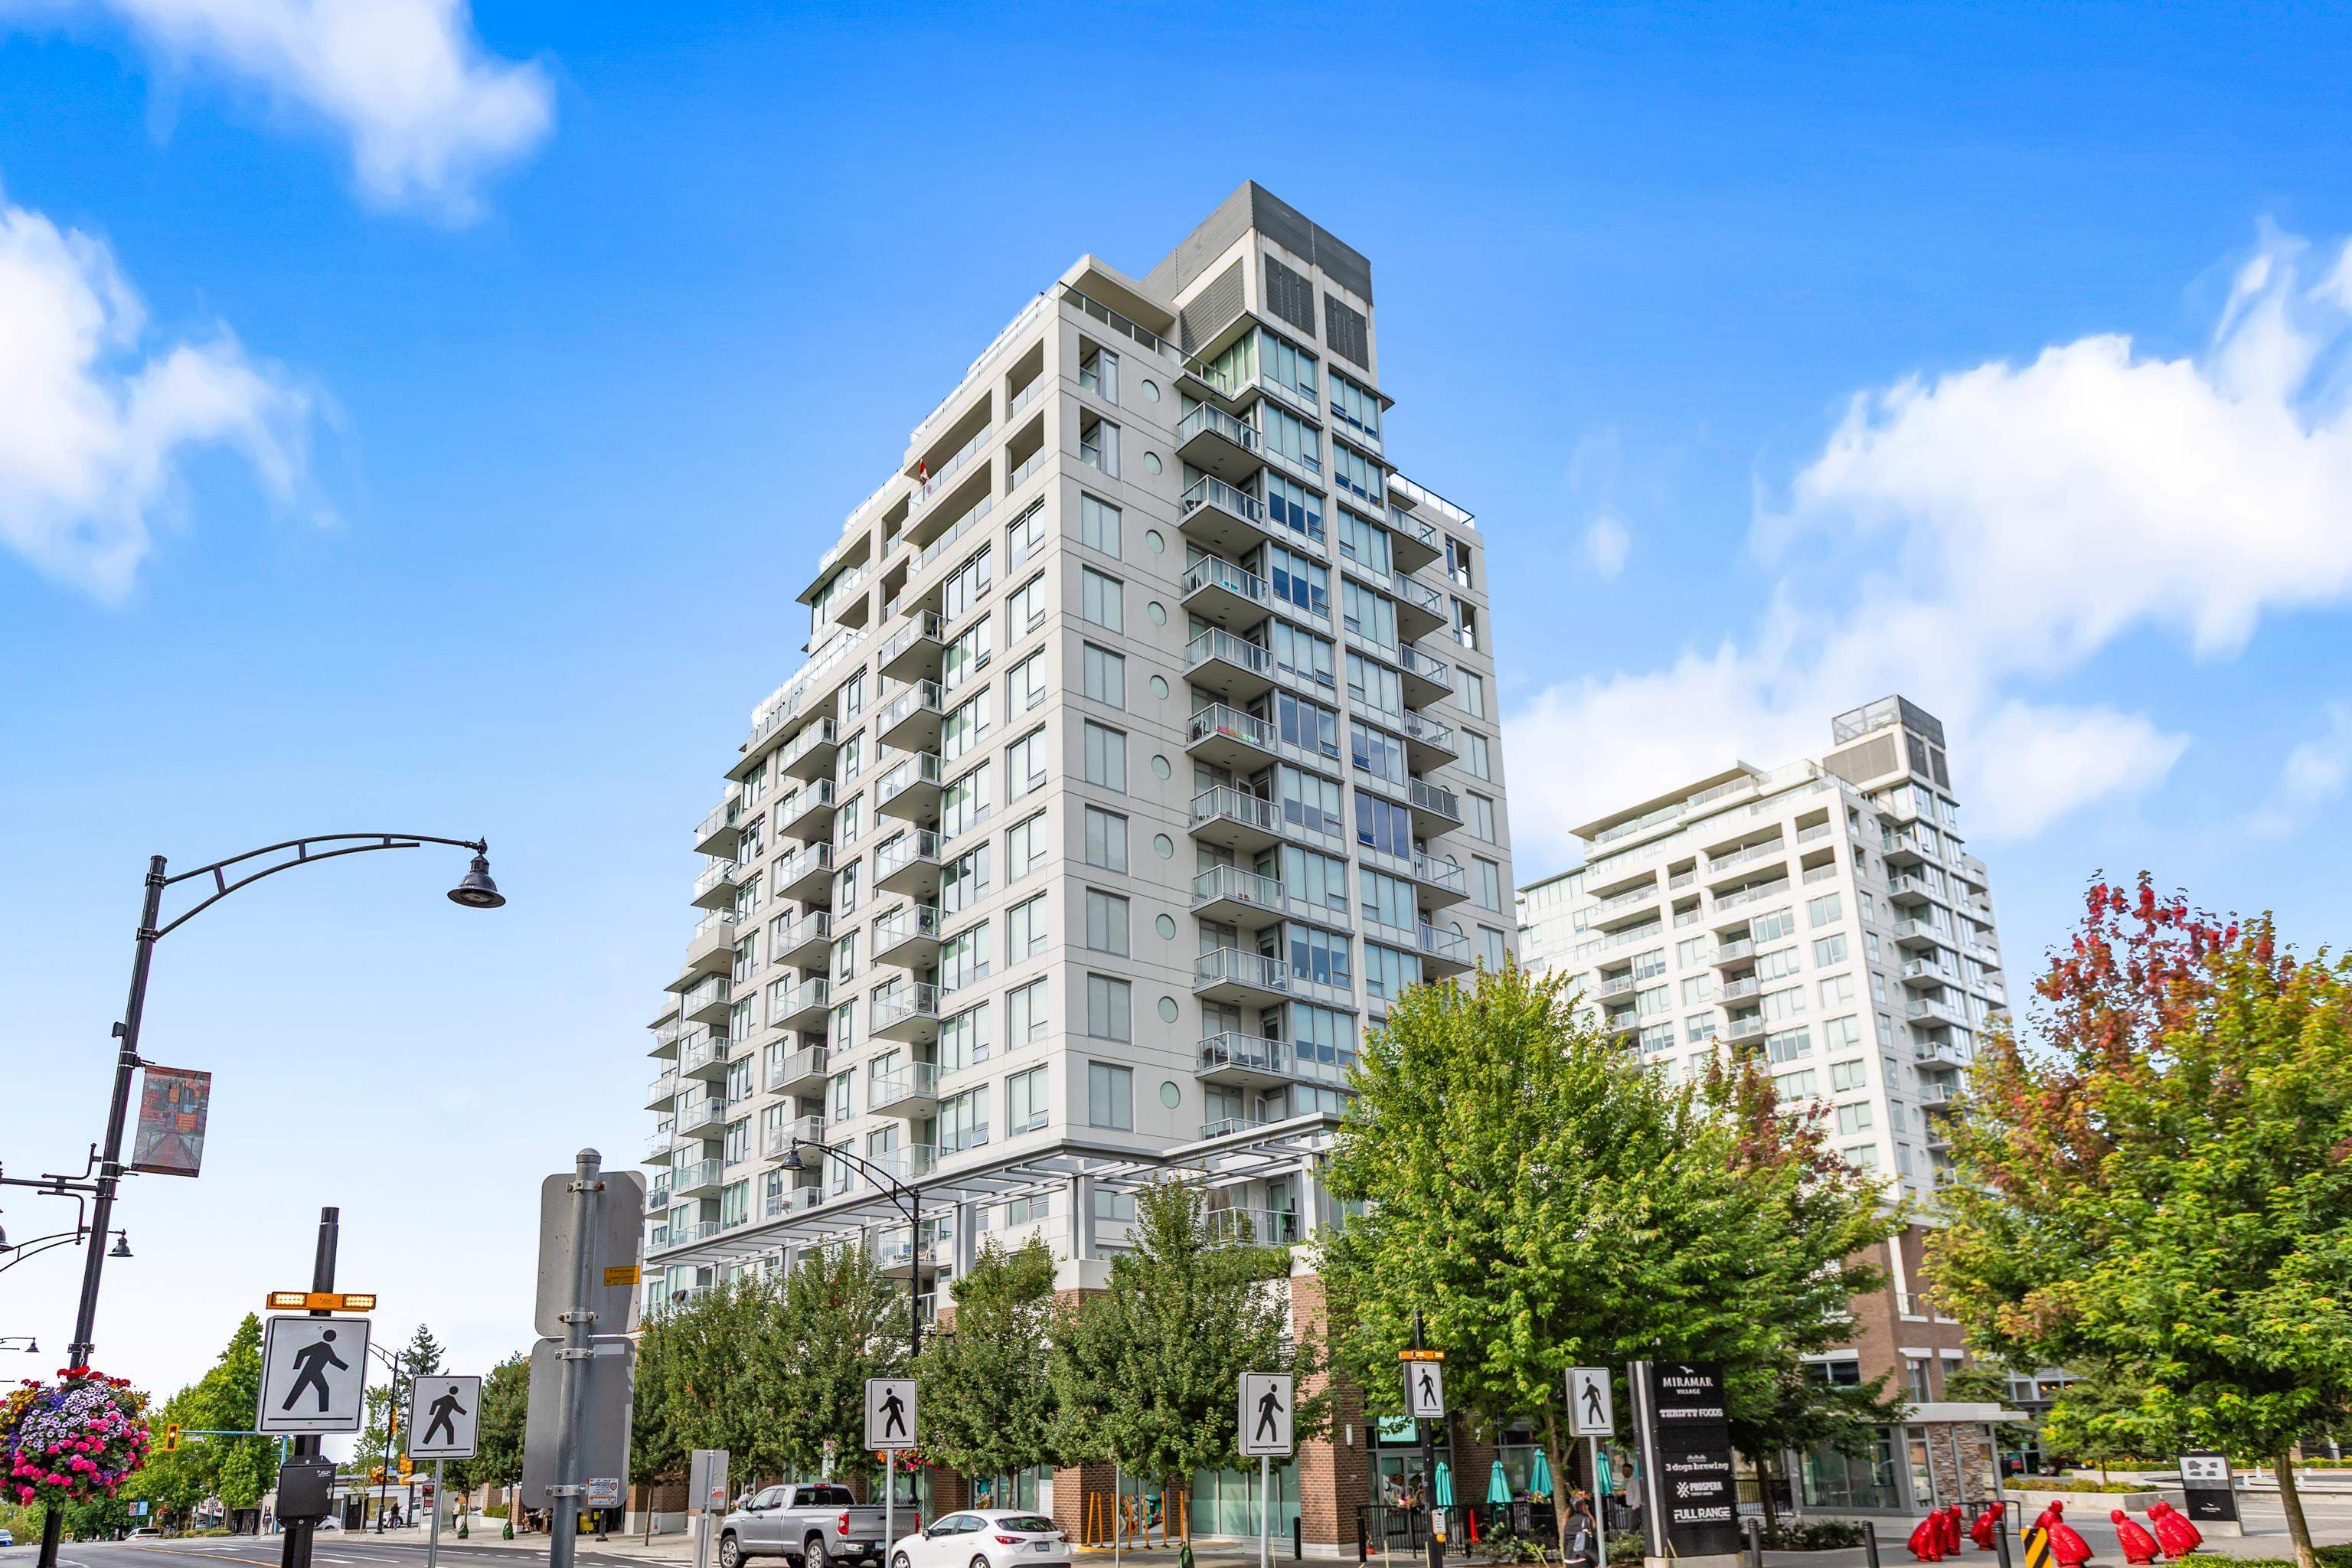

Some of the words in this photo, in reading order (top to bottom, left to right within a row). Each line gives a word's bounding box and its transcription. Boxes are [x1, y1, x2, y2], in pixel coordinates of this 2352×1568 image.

[1663, 1377, 1713, 1387] MIRAMAR
[1659, 1409, 1698, 1418] THRIFTY
[1699, 1408, 1723, 1417] FOODS
[1672, 1463, 1693, 1472] dogs
[1693, 1462, 1729, 1471] brewing
[1689, 1481, 1723, 1492] PROSPERA
[1674, 1508, 1698, 1520] FULL
[1698, 1507, 1731, 1517] RANGE
